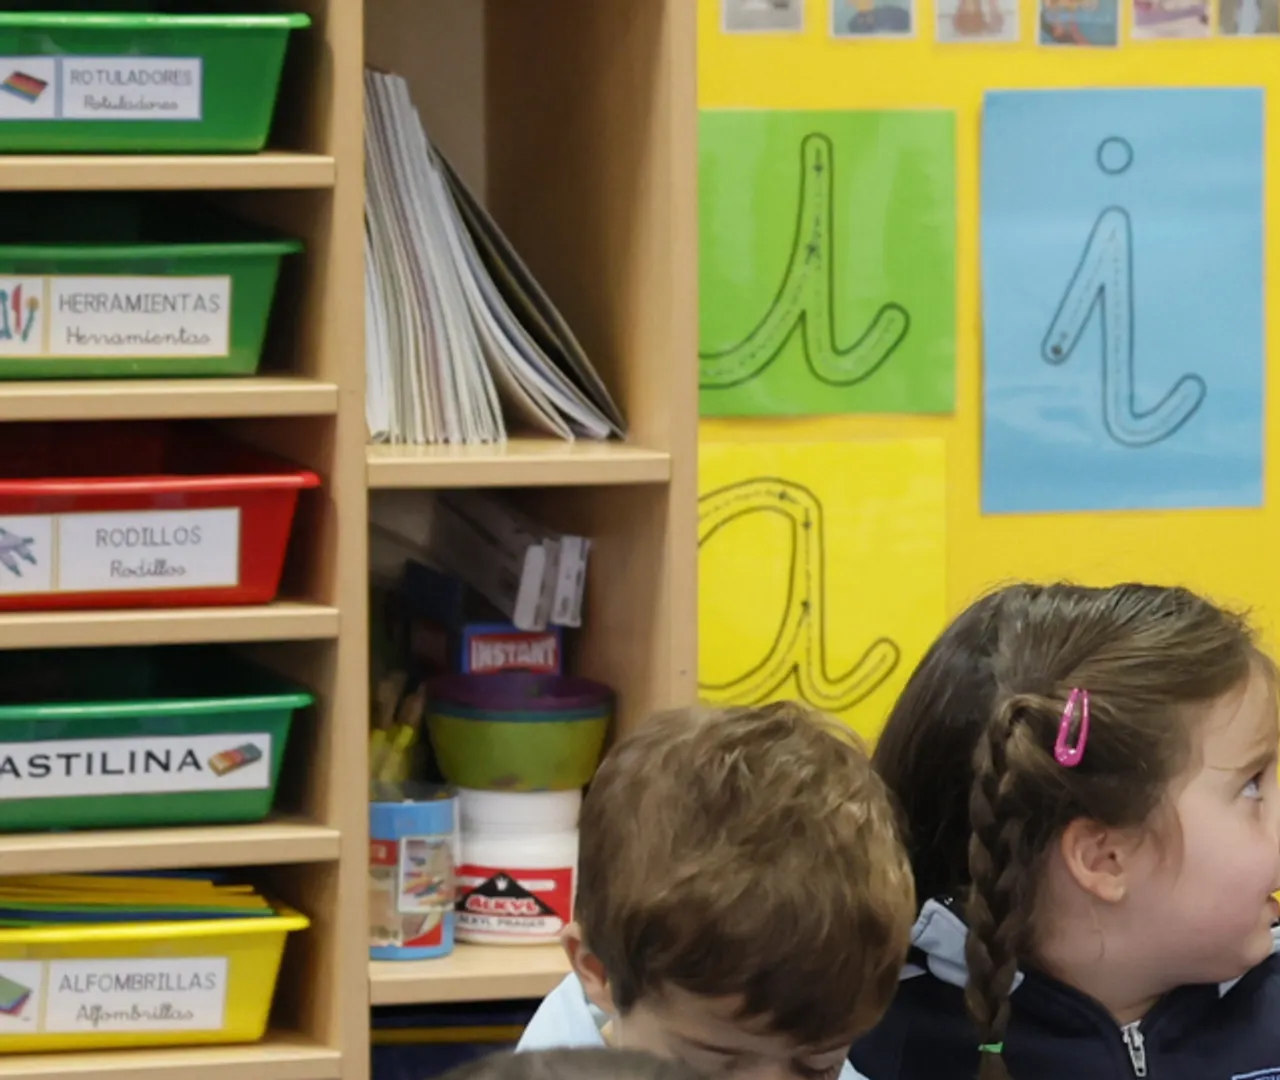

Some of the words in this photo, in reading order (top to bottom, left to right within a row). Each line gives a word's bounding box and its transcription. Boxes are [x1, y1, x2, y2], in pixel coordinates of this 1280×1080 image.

[69, 69, 193, 87] ROTULADORES
[83, 94, 179, 111] Rotuladores
[1041, 136, 1207, 447] i
[58, 293, 221, 314] HERRAMIENTAS
[65, 325, 212, 345] Herramientas
[95, 525, 202, 548] RODILLOS
[109, 558, 187, 579] Rodillos
[470, 636, 557, 672] INSTANT
[58, 972, 217, 993] ALFOMBRILLAS
[76, 1002, 194, 1027] Alfombrillas
